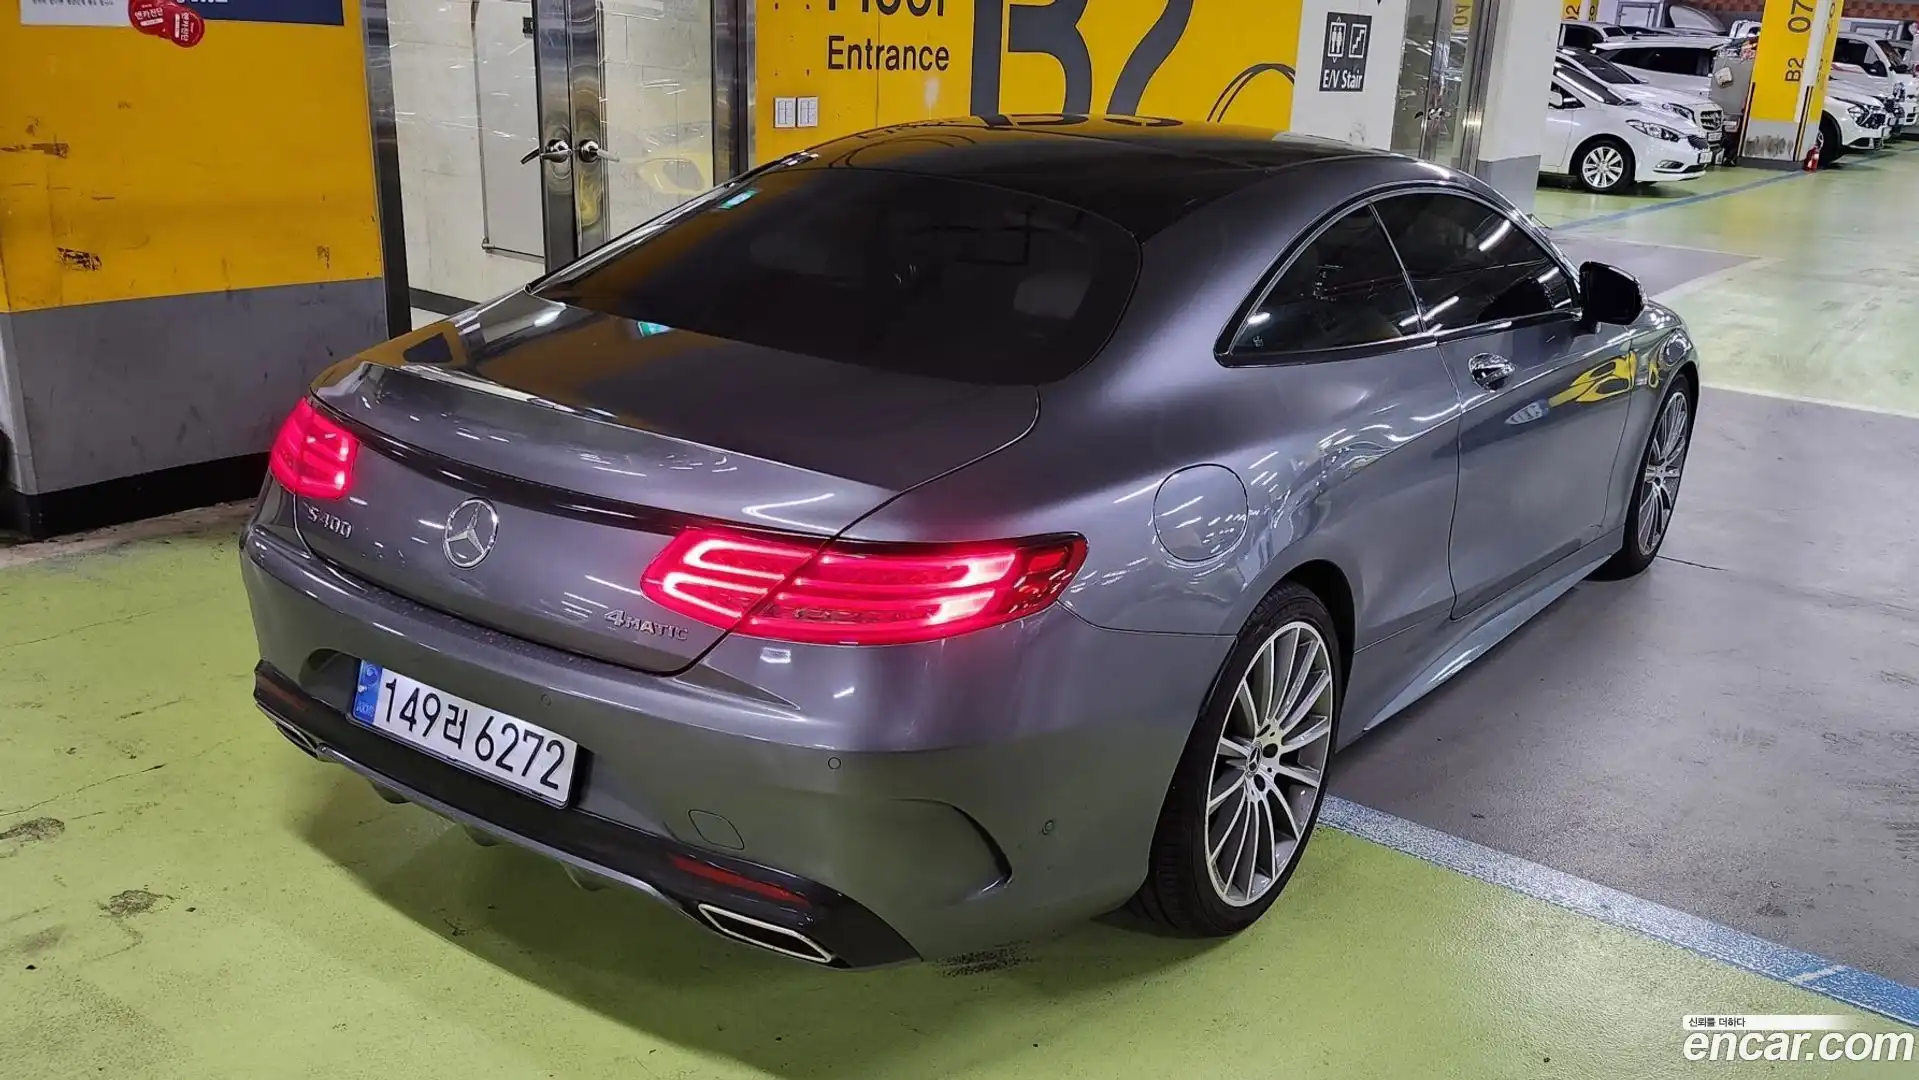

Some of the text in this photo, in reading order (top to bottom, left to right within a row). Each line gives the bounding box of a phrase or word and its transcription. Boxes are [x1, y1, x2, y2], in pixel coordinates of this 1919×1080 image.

[827, 35, 949, 71] Entrance
[1784, 0, 1813, 82] B2 07
[1322, 69, 1363, 89] E/V Stair
[604, 609, 689, 642] 4MATIC
[385, 678, 565, 790] 149러 6272
